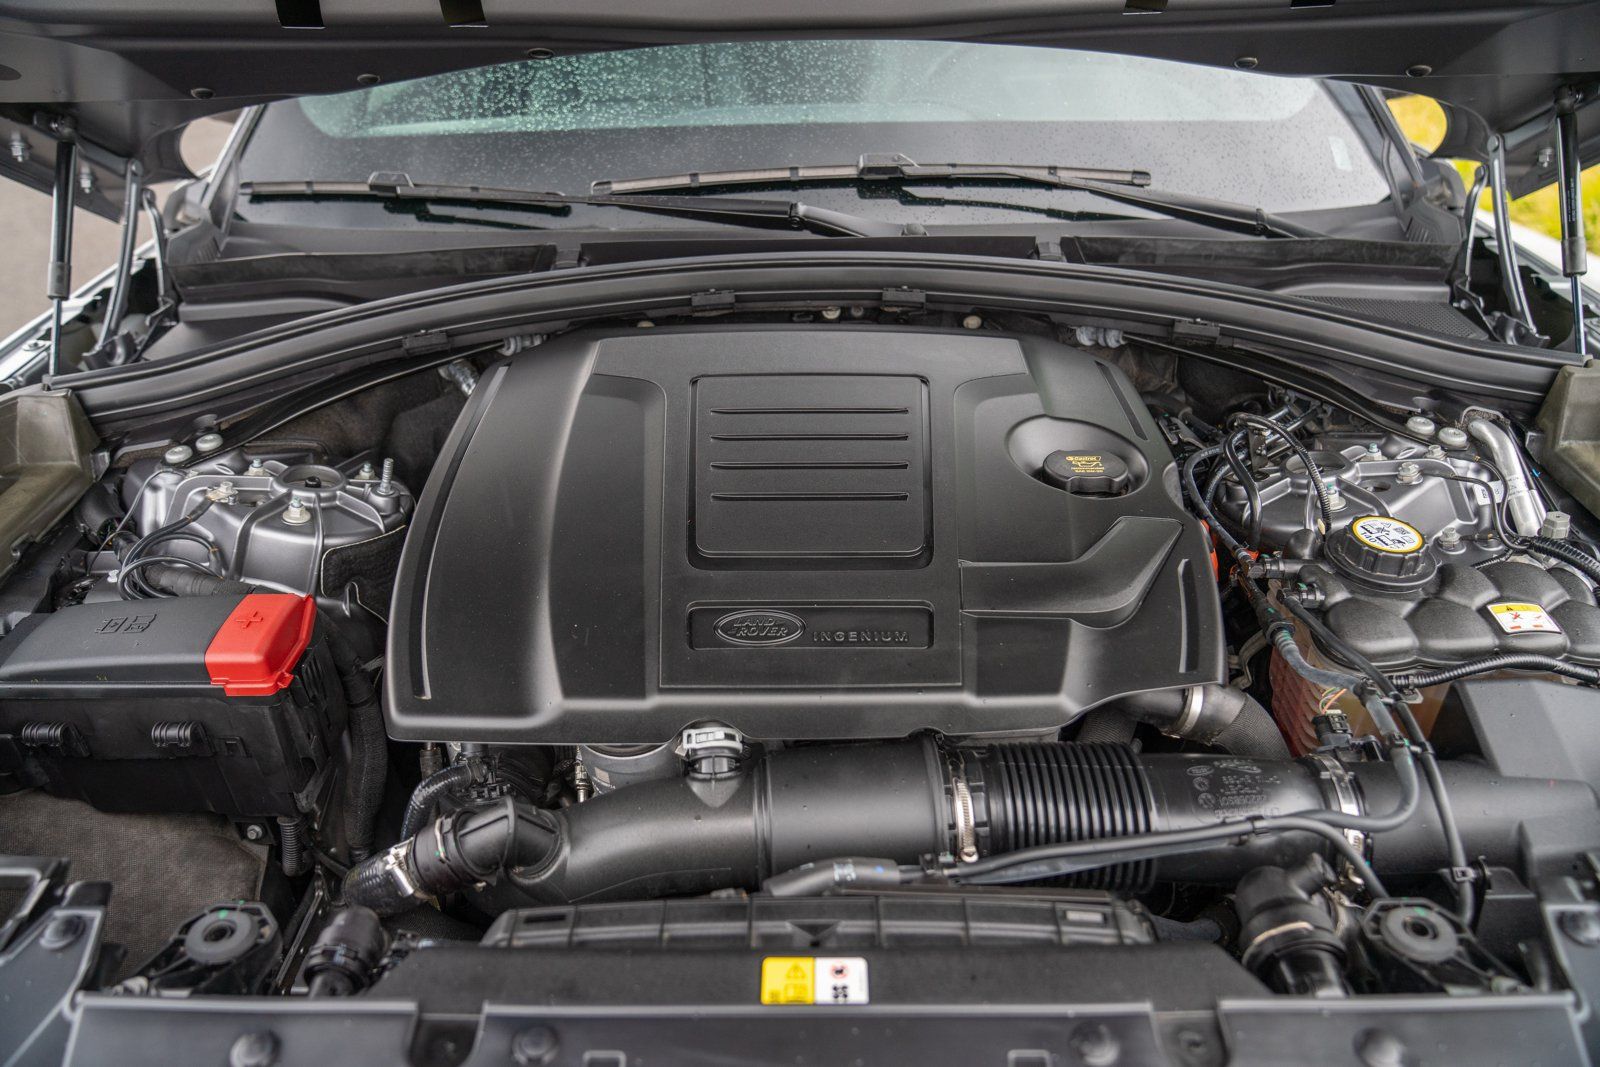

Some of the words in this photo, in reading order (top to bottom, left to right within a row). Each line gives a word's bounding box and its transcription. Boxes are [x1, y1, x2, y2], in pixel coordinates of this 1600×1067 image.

[733, 618, 775, 627] LAND
[735, 626, 789, 637] ROVER
[813, 631, 909, 642] INGENIUM
